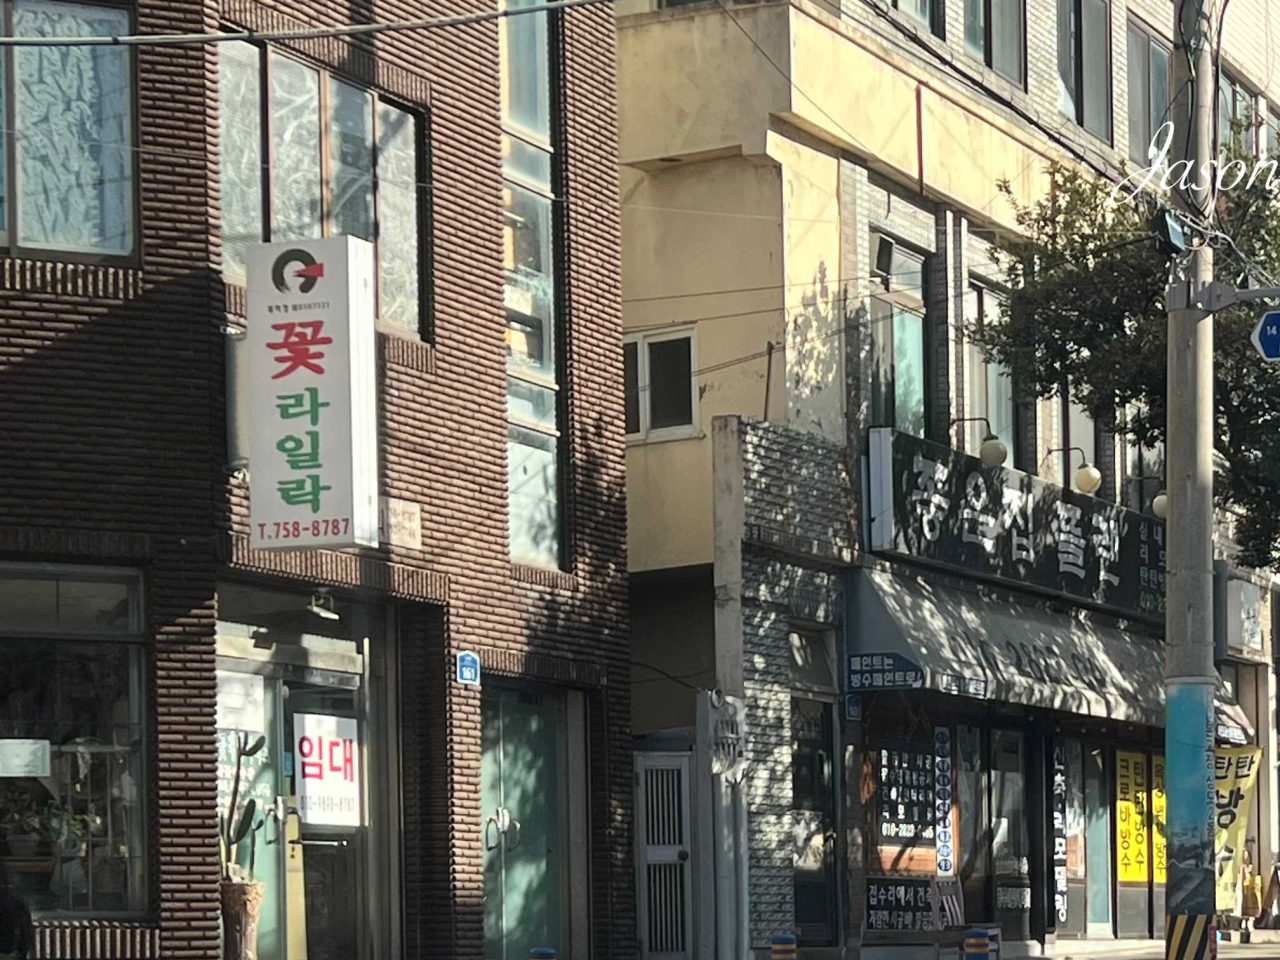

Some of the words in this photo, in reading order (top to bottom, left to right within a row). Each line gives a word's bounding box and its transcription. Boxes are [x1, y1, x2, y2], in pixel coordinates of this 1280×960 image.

[265, 320, 333, 380] 꽃
[276, 386, 332, 514] 라일락
[258, 518, 350, 540] T.758-8787
[298, 735, 354, 783] 임대
